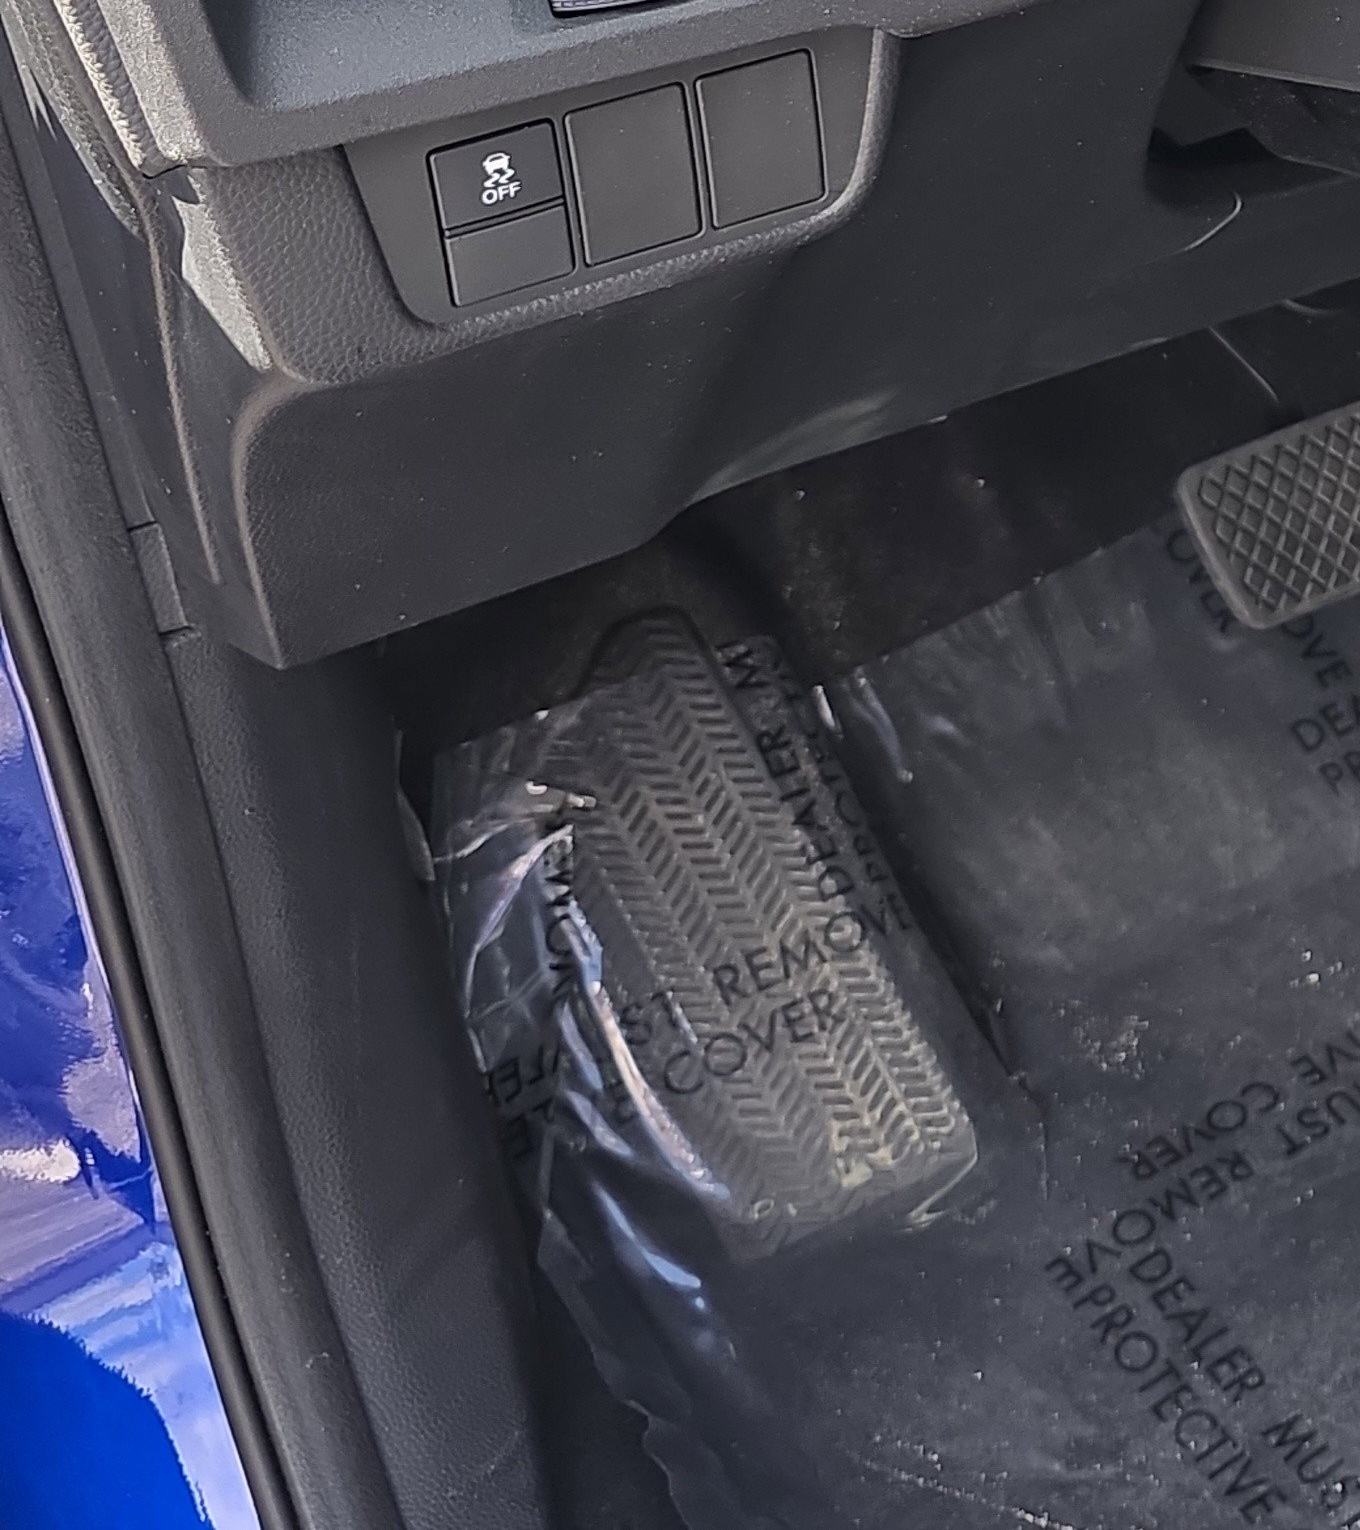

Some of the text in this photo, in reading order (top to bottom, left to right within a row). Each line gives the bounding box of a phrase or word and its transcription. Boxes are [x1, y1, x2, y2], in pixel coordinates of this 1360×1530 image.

[481, 181, 521, 205] OFF
[665, 988, 850, 1096] COVER
[1115, 1080, 1281, 1183] COVER
[1044, 1150, 1257, 1294] REMOVE
[1128, 1247, 1267, 1403] DEALER
[1071, 1280, 1289, 1525] PROTECTIVE
